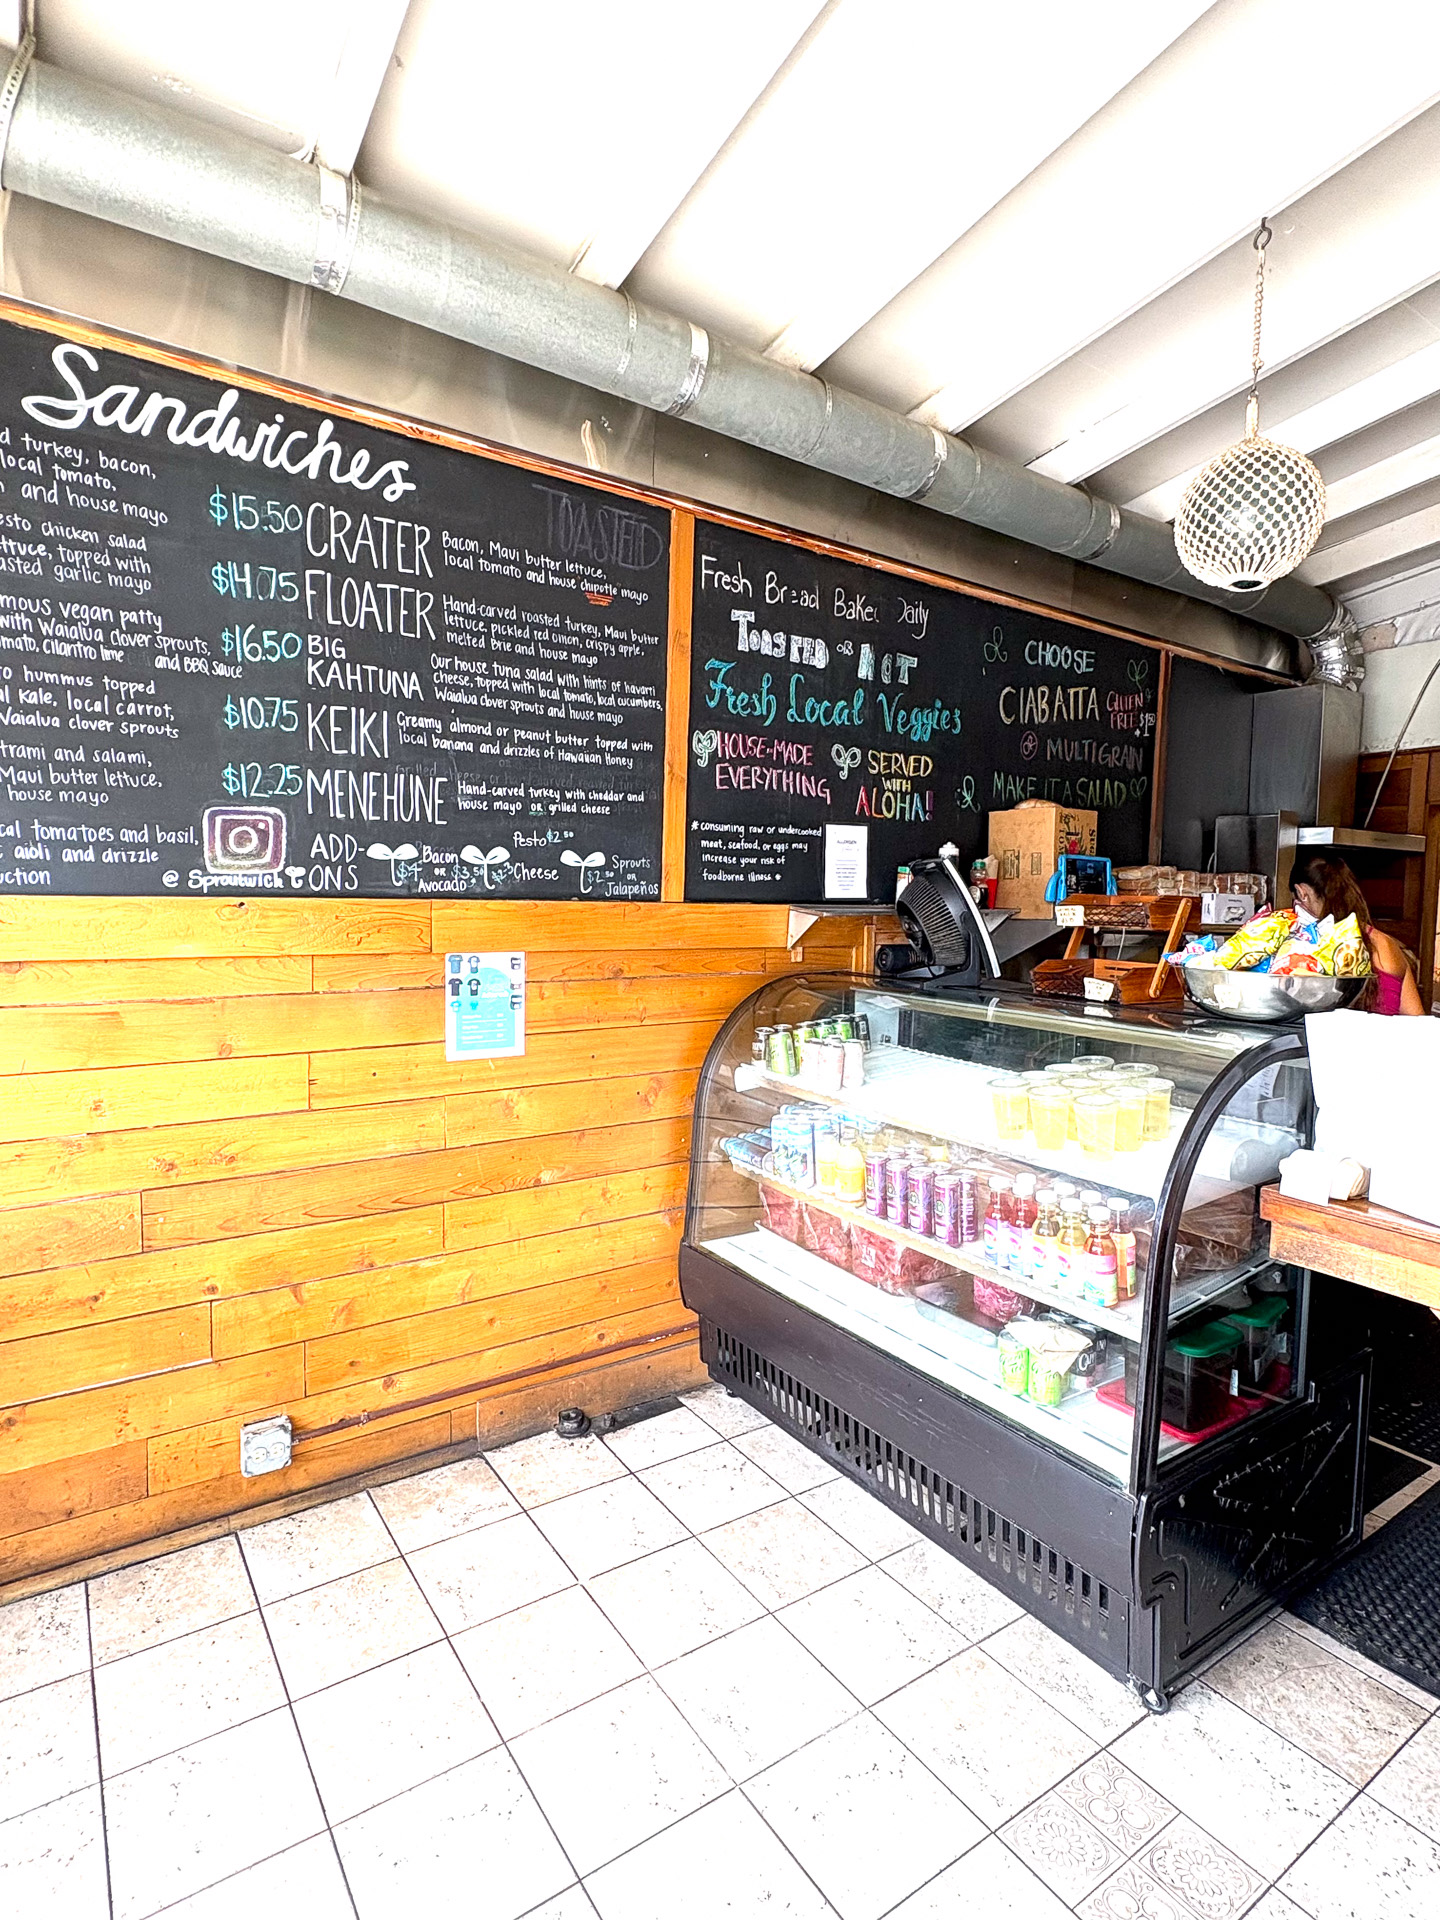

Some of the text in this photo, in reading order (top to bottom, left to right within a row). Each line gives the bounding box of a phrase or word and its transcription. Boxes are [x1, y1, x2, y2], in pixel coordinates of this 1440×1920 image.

[21, 343, 416, 502] Sandwiches
[21, 433, 89, 467] turkey,
[98, 450, 156, 480] bacon,
[52, 463, 117, 491] tomato,
[21, 480, 168, 527] and house mayo
[41, 521, 147, 551] chicken salad
[209, 485, 434, 578] $15.50 CRATER
[56, 543, 151, 574] topped with
[442, 531, 606, 580] Bacon, Maui butter lettuce,
[54, 565, 151, 596] garlic mayo
[444, 549, 649, 605] local tomato and house mayo
[701, 554, 752, 597] Fresh
[59, 601, 162, 634] vegan patty
[305, 569, 436, 641] FLOATER
[443, 594, 659, 645] Hand-carved roasted turkey, Maui butter
[38, 617, 211, 655] Waialua clover sprouts,
[221, 624, 303, 663] $16.50
[308, 634, 346, 659] BIG
[447, 631, 598, 667] melted Brie and house mayo
[491, 623, 615, 656] pickled red crispy
[101, 644, 124, 662] lime
[155, 653, 243, 679] and BBQ sauce
[1024, 640, 1096, 674] CHOOSE
[23, 665, 156, 700] hummus topped
[308, 657, 425, 701] KAHTUNA
[431, 653, 656, 696] Our house tuna salad with hints of havarti
[66, 690, 175, 721] local carrot,
[434, 686, 623, 726] Waialua clover sprouts and house mayo
[474, 676, 615, 707] topped with local tomato, local
[704, 657, 961, 742] Fresh Local Veggies
[1000, 685, 1099, 725] CIABATTA
[68, 715, 179, 739] clover sprouts
[223, 694, 389, 758] $10.75 KEIKI
[450, 717, 653, 751] almond or peanut butter topped with
[54, 745, 152, 768] and salami,
[399, 728, 633, 769] local banana and drizzles of Hawaiian Honey
[867, 750, 933, 777] SERVED
[1047, 738, 1143, 771] MULTIGRAIN
[49, 763, 163, 788] butter lettuce,
[457, 780, 644, 802] Hand-carved turkey with cheddar and
[715, 763, 831, 805] EVERYTHING
[882, 776, 911, 793] WITH
[993, 771, 1037, 805] MAKE
[1044, 778, 1061, 800] IT
[1076, 777, 1127, 807] SALAD
[7, 784, 109, 807] house mayo
[222, 762, 448, 824] $12.25 MENEHUNE
[457, 797, 610, 815] house mayo grilled cheese
[856, 785, 934, 822] ALOHA!
[32, 818, 199, 846] tomatoes and basil,
[513, 830, 546, 847] Pesto
[701, 839, 726, 850] meat,
[773, 843, 788, 852] eggs
[792, 843, 808, 852] may
[749, 824, 822, 836] raw or undercooked
[61, 845, 159, 864] and drizzle
[423, 845, 458, 864] Bacon
[612, 855, 650, 874] Sprouts
[702, 853, 736, 864] increase
[740, 857, 757, 867] your
[777, 856, 785, 864] of
[309, 864, 358, 891] ONS
[418, 878, 467, 893] Avocado
[513, 861, 559, 880] Cheese
[702, 868, 744, 881] foodborne
[605, 881, 658, 899] Jalapeños
